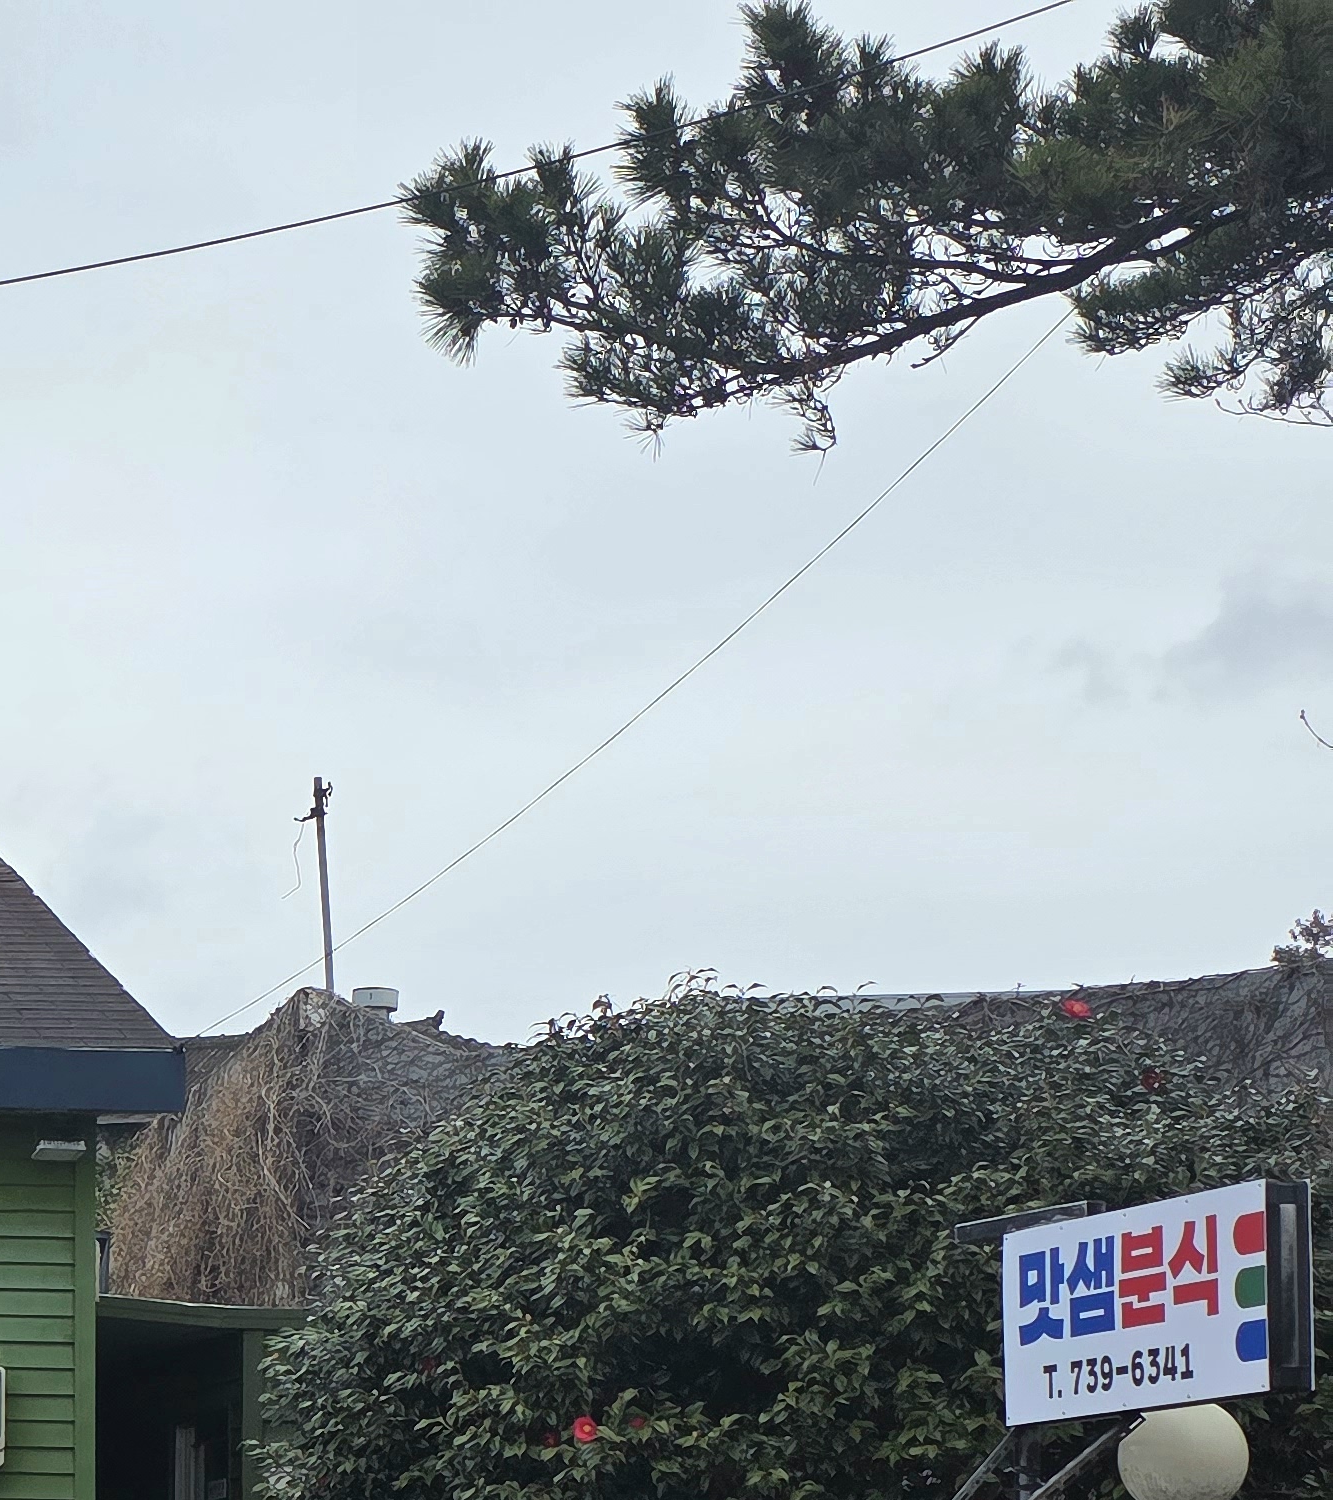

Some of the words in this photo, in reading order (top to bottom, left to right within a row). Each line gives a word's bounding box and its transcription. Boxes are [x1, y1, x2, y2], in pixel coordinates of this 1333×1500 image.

[1019, 1214, 1219, 1346] 맛샘분식
[1043, 1364, 1062, 1398] T.
[1071, 1344, 1193, 1394] 739-6341
